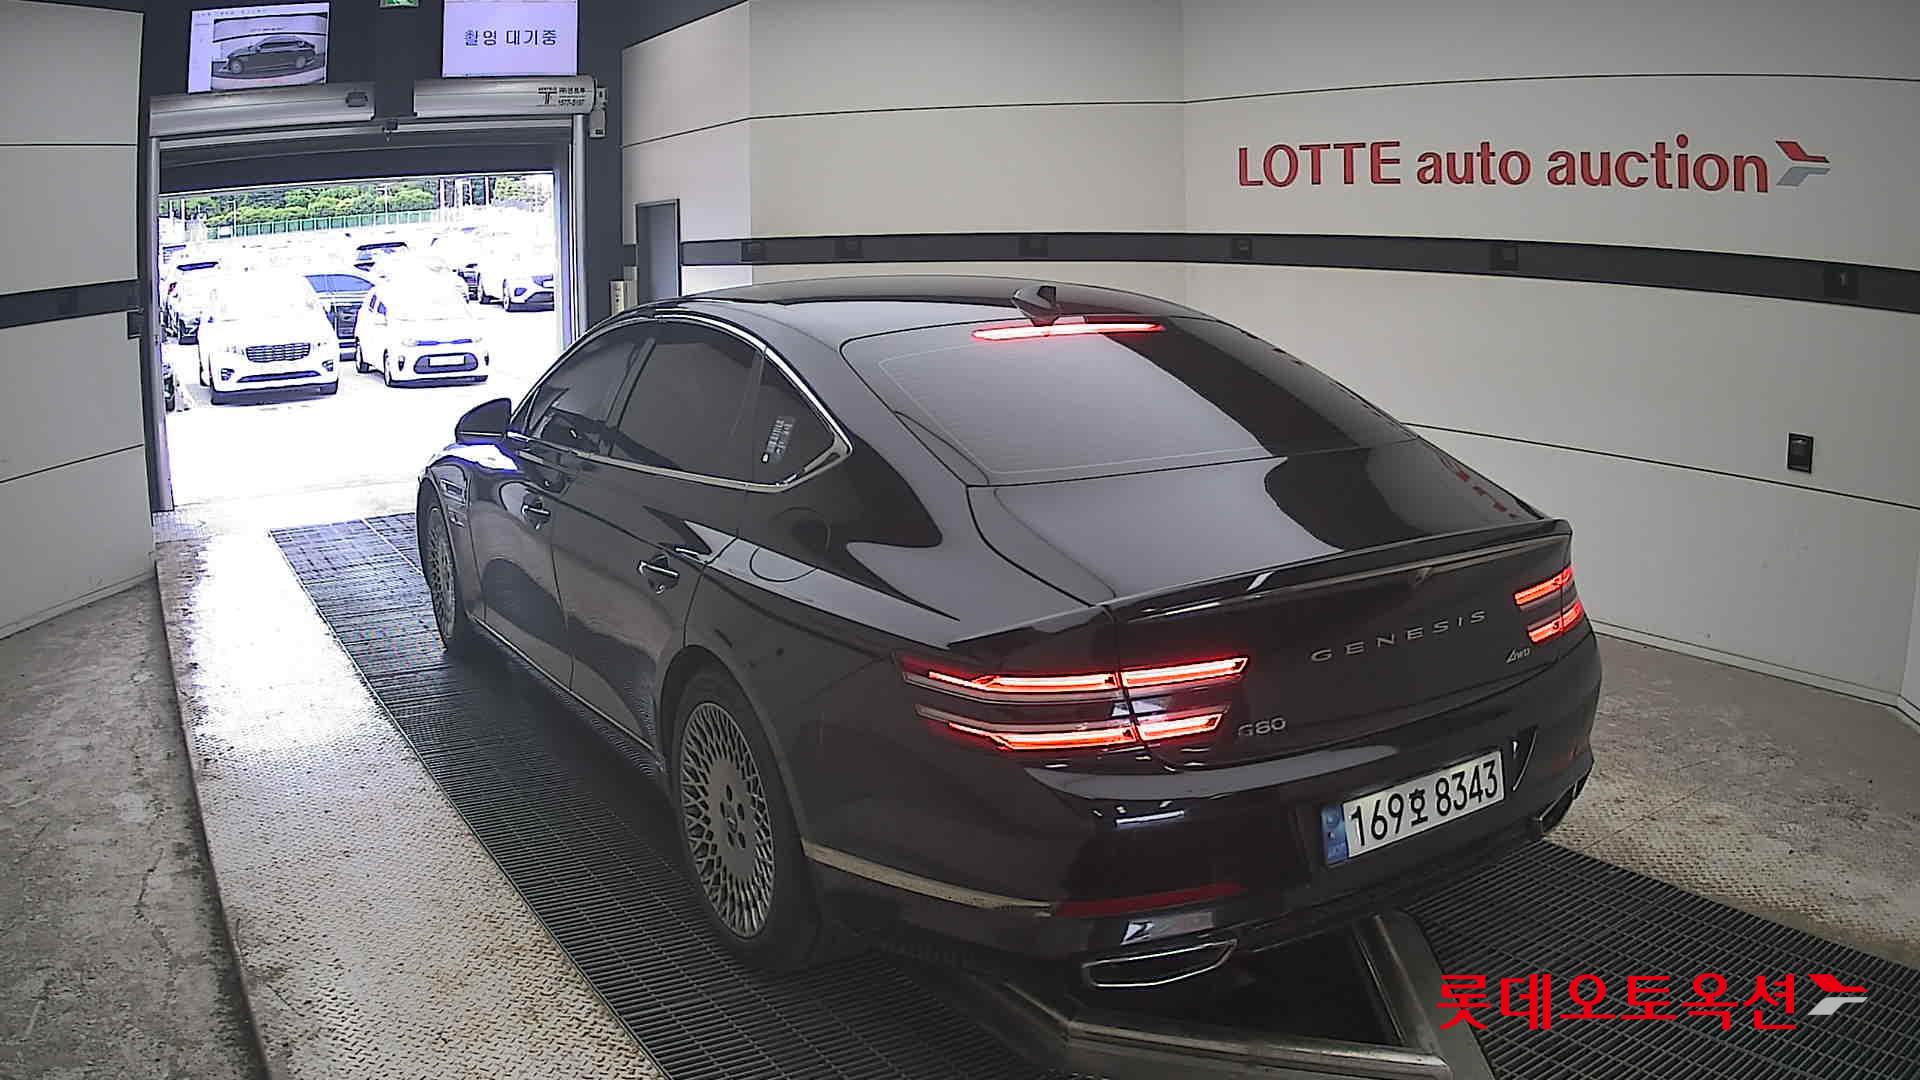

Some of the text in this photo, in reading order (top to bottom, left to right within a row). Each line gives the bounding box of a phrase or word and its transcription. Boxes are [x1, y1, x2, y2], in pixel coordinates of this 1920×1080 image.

[505, 29, 557, 46] 대기중
[1238, 134, 1769, 193] LOTTE auto auction
[1310, 610, 1486, 663] GENESIS
[1238, 717, 1286, 737] G80
[1351, 759, 1498, 848] 169호 8343
